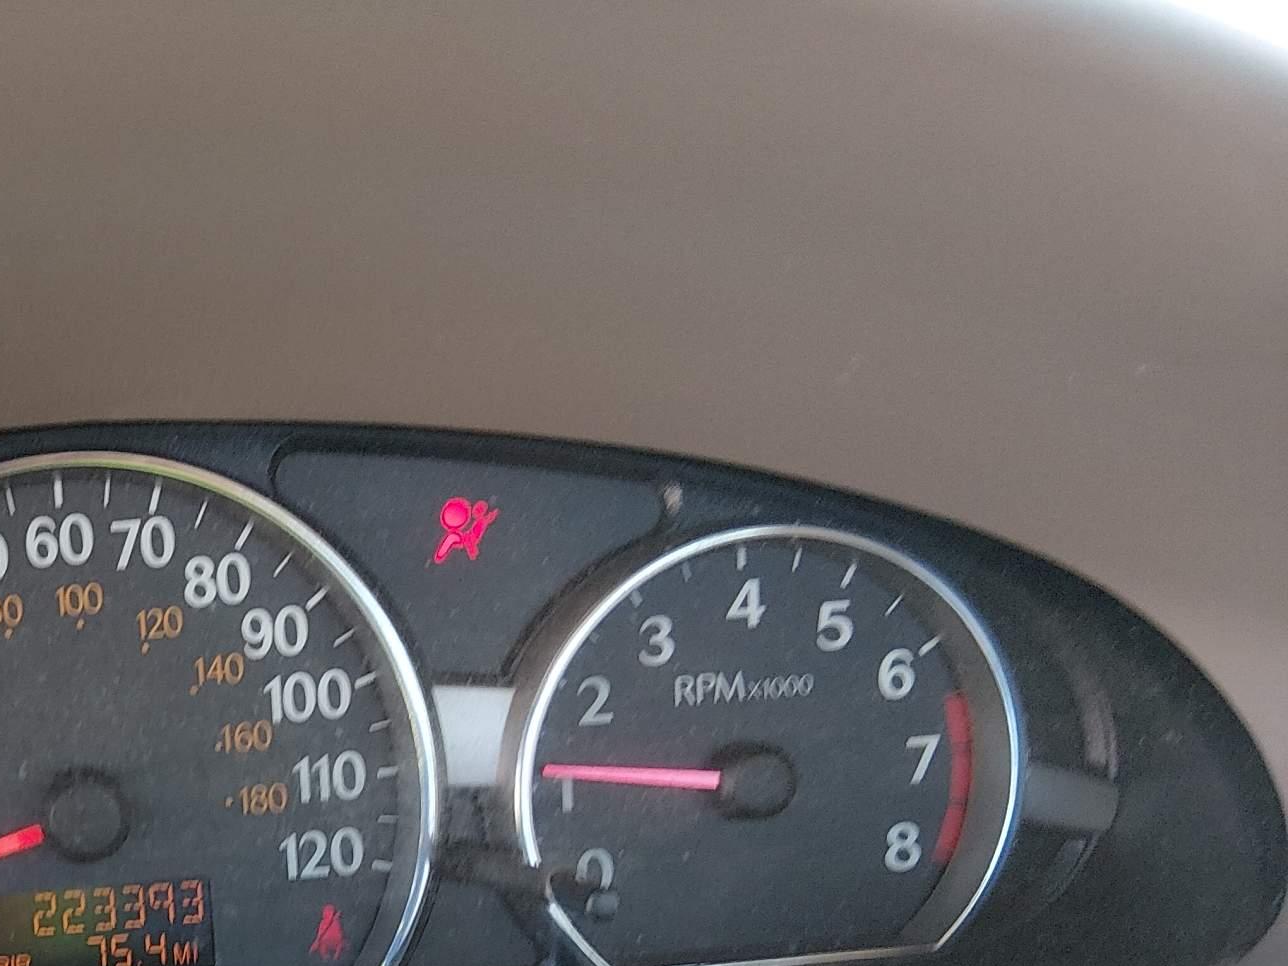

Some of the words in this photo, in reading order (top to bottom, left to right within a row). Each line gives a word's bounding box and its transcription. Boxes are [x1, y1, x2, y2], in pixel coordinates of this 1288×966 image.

[25, 512, 93, 567] 60
[110, 515, 176, 571] 70
[56, 581, 103, 616] 100
[184, 552, 251, 608] 80
[726, 578, 766, 629] 4
[136, 605, 183, 640] 120
[241, 605, 309, 660] 90
[638, 614, 675, 668] 3
[816, 599, 854, 652] 5
[194, 651, 245, 686] 140
[878, 648, 917, 700] 6
[263, 668, 351, 724] 100
[577, 675, 614, 727] 2
[222, 720, 273, 753] 160
[905, 733, 942, 785] 7
[239, 783, 288, 815] 180
[292, 751, 366, 804] 110
[280, 826, 364, 881] 120
[884, 821, 921, 873] 8
[32, 880, 205, 936] 223393
